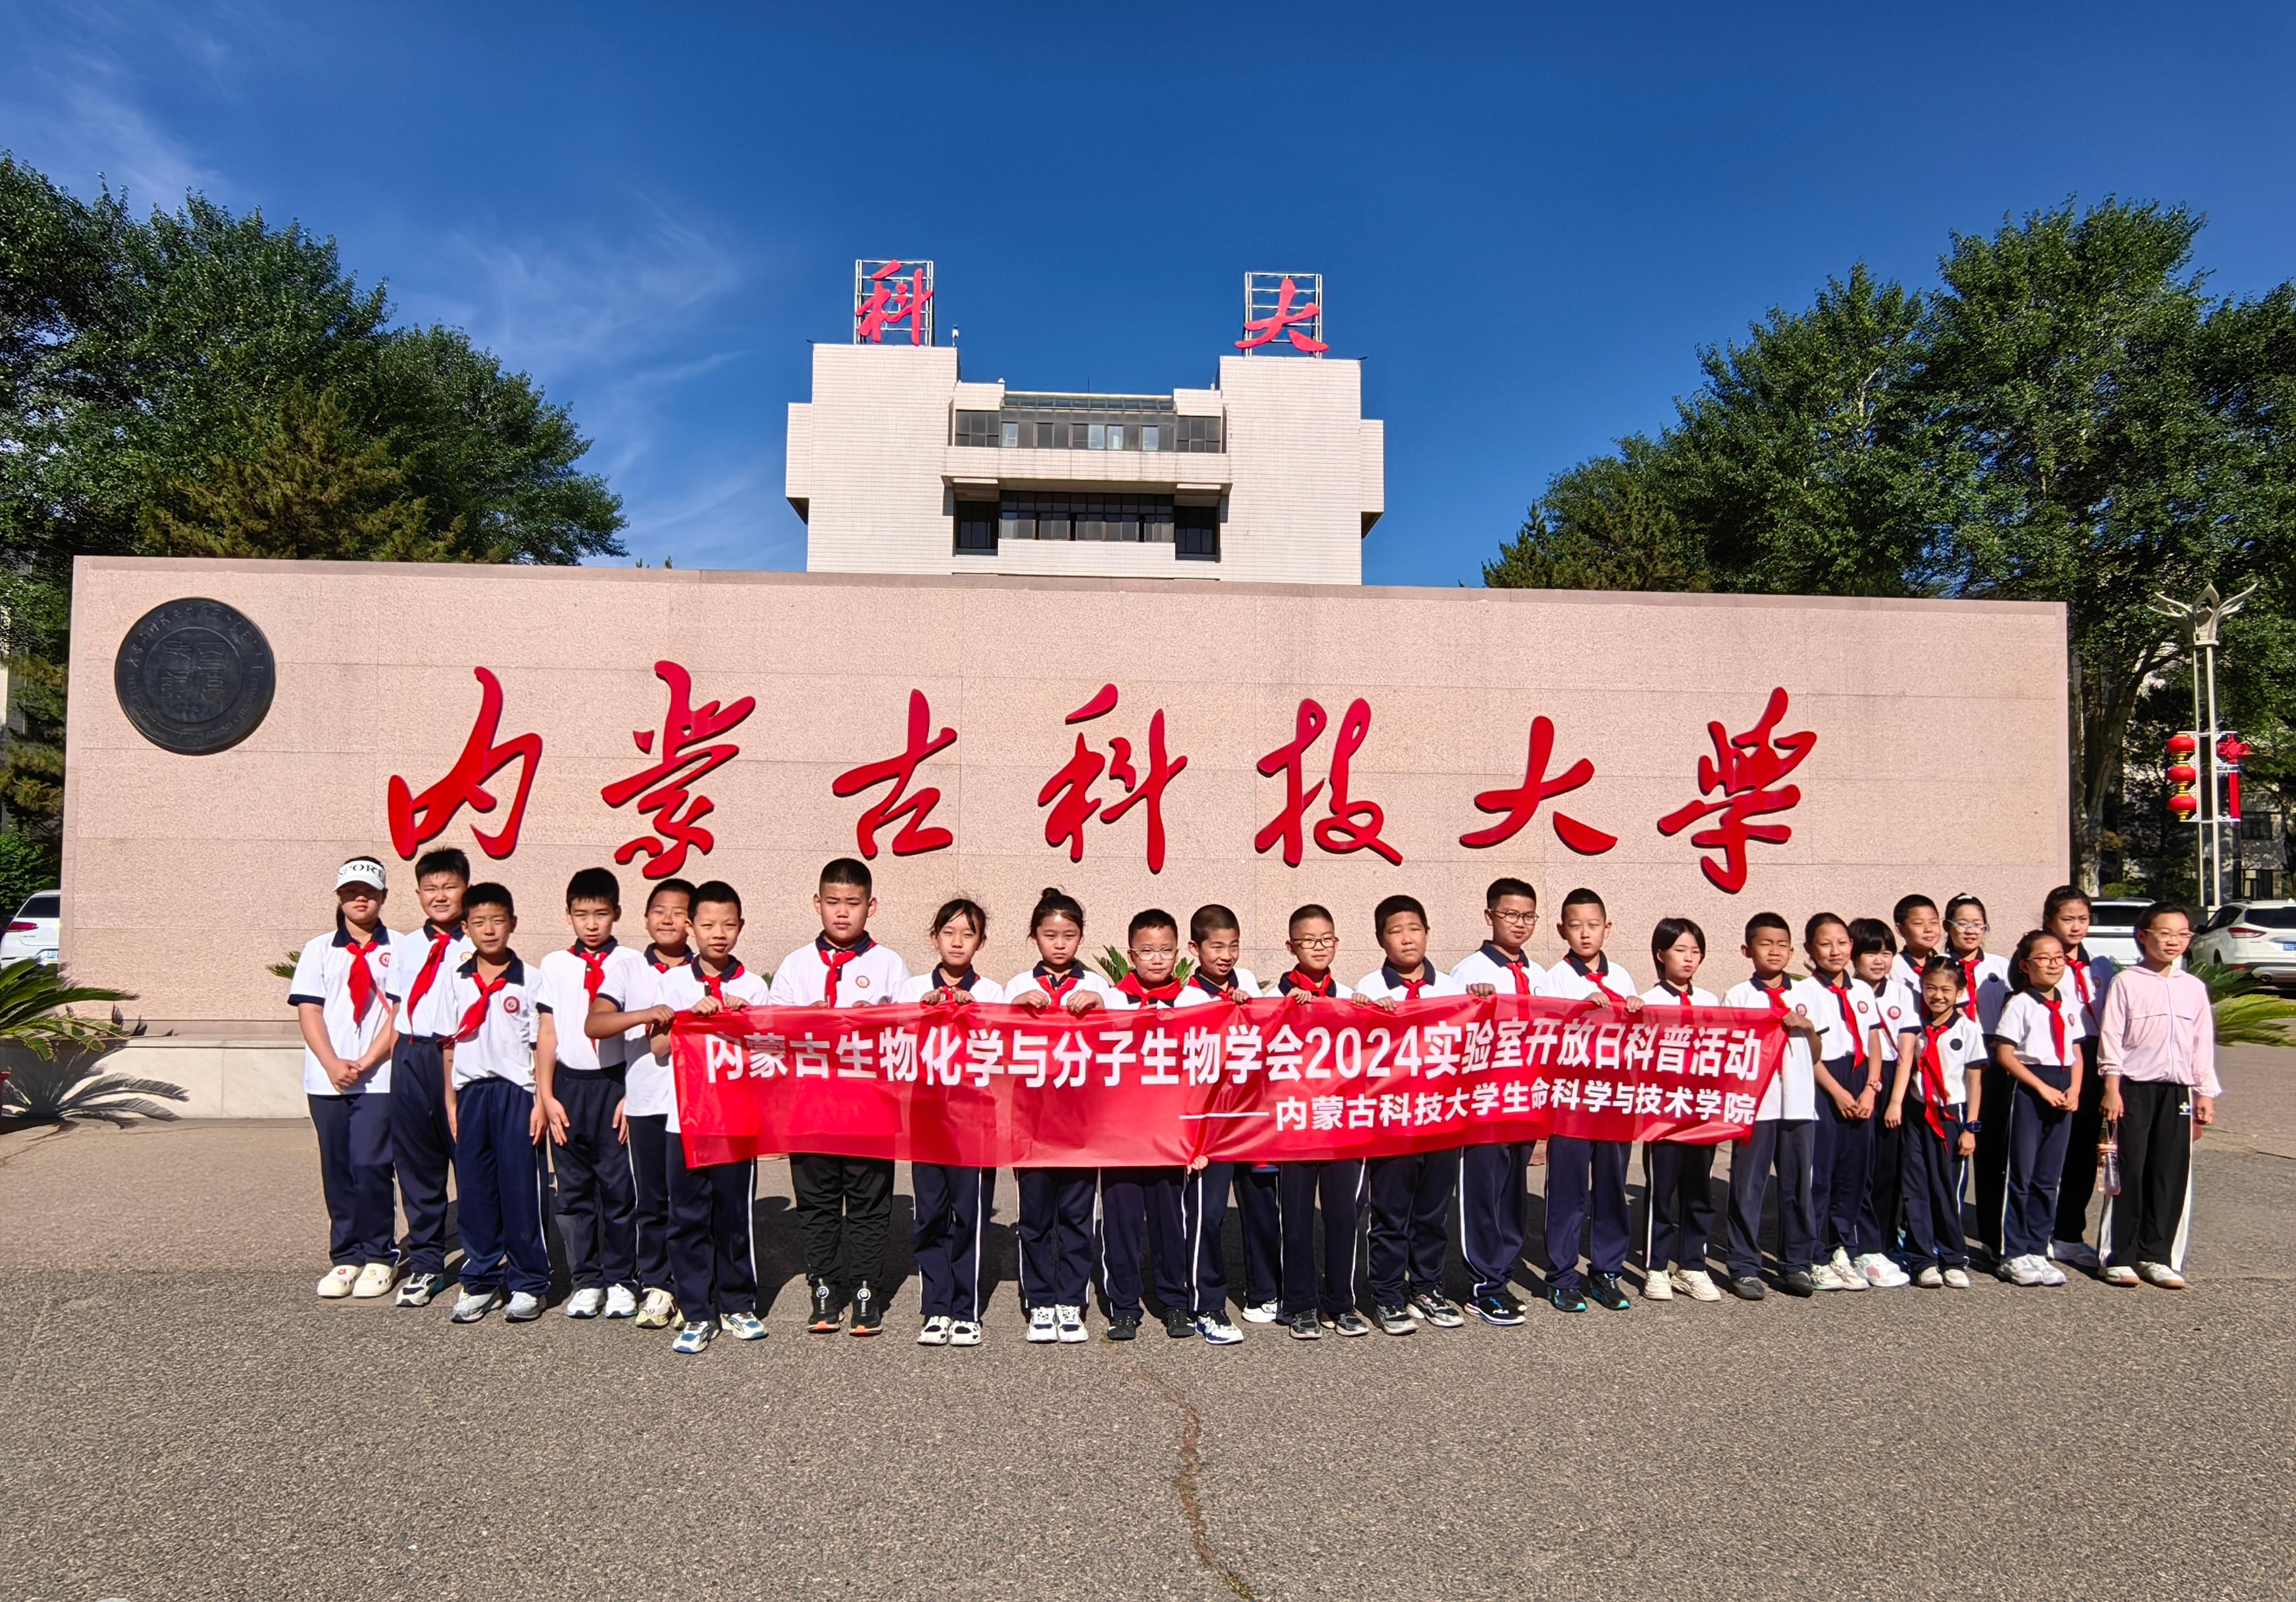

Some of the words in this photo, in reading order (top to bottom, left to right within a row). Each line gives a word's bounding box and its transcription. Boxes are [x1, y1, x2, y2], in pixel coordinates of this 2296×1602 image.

[856, 259, 933, 346] 科
[1235, 278, 1329, 353] 大
[387, 660, 1818, 893] 内蒙古科技大学
[704, 1017, 1762, 1089] 内蒙古生物化学与分子生物学会2024实验室开放日科普活动
